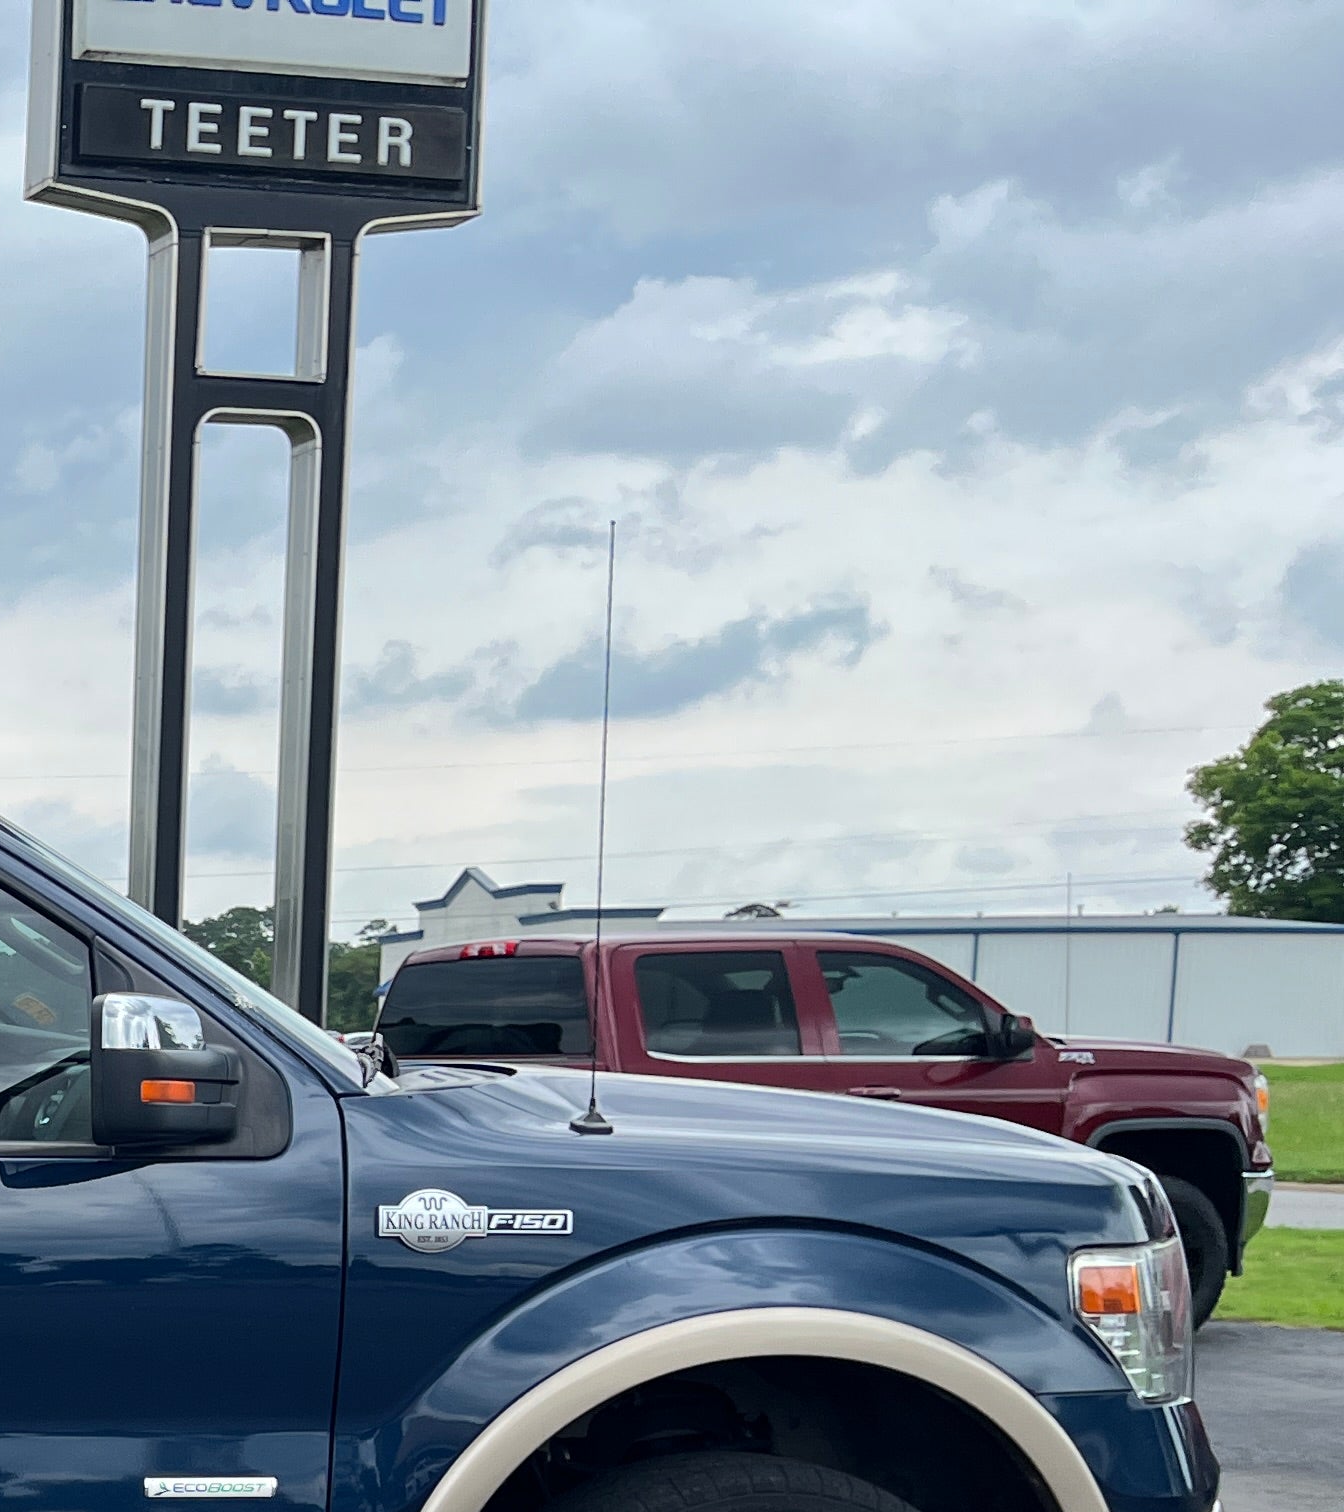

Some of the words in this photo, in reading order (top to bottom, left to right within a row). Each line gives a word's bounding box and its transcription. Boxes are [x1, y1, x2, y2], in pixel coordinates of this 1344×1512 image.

[139, 97, 414, 168] TEETER
[385, 1211, 424, 1230] KING
[428, 1211, 482, 1230] RANCH
[490, 1214, 565, 1229] F-150
